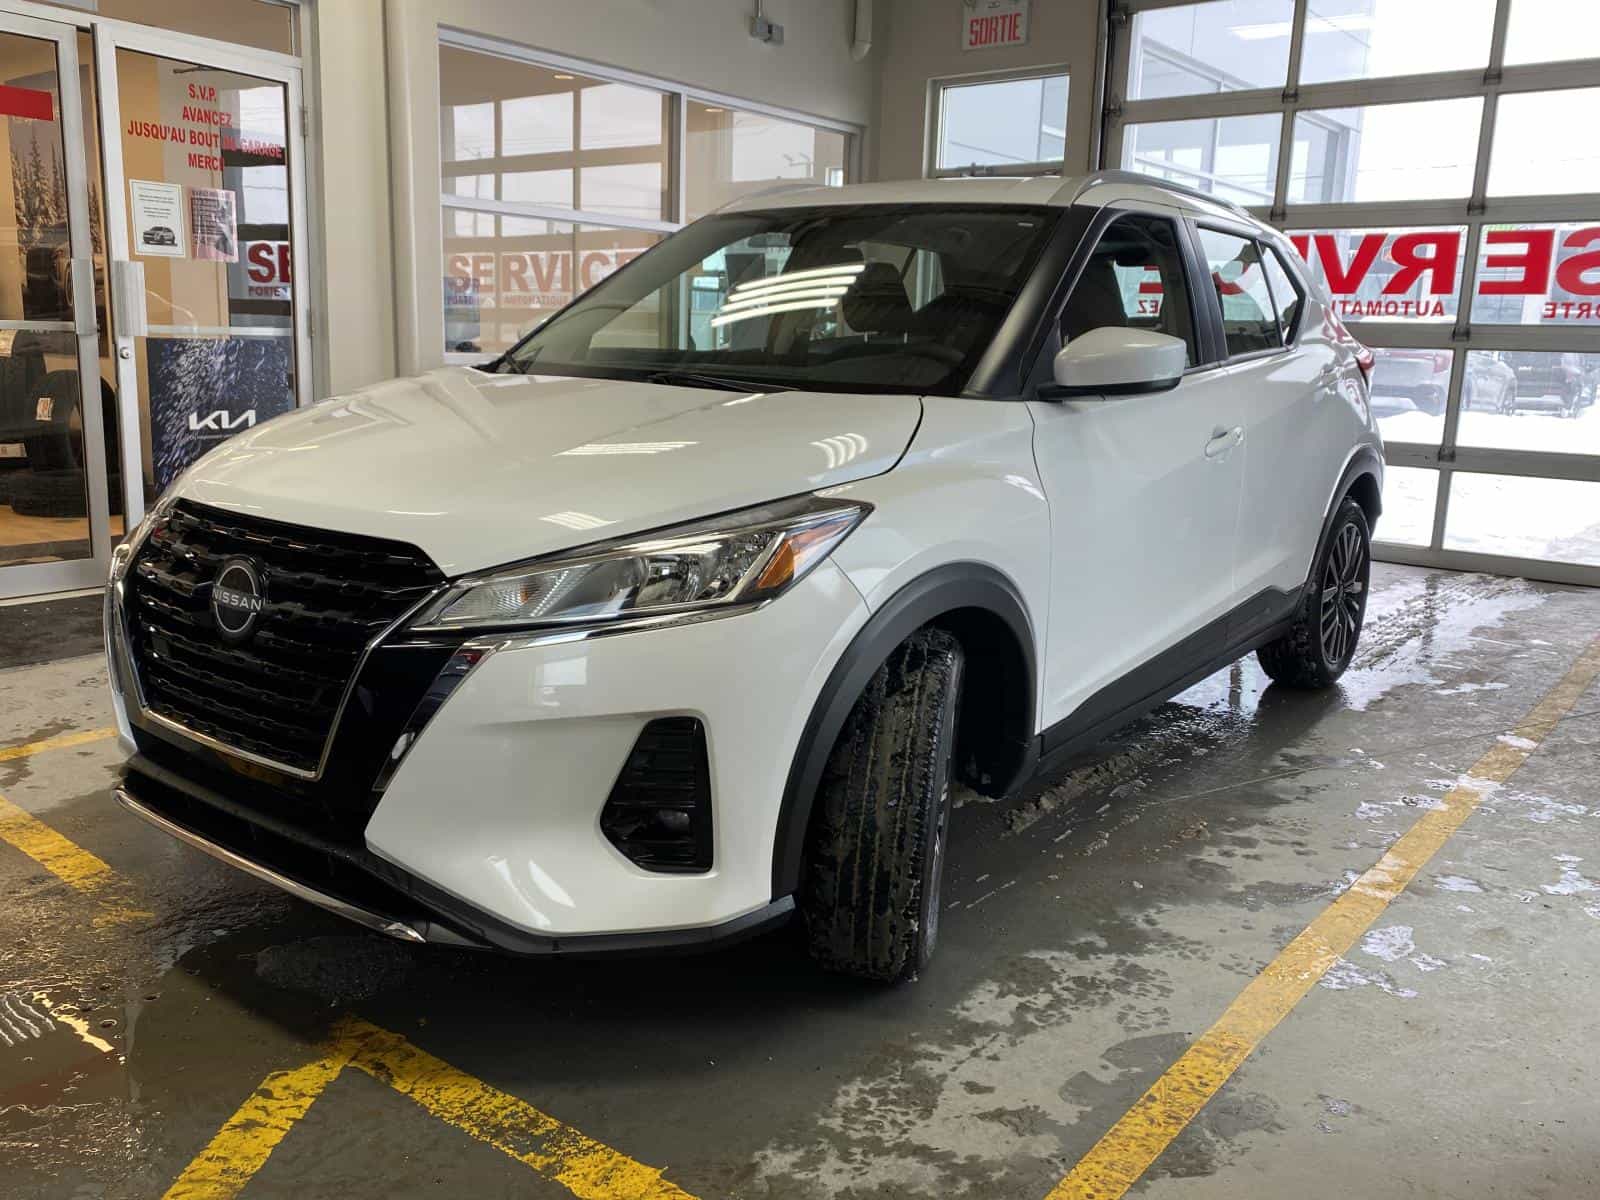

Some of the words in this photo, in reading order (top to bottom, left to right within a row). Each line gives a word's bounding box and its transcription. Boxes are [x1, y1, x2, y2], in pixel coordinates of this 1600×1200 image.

[968, 12, 1022, 46] SORTIE
[188, 83, 217, 102] S.V.P.
[182, 105, 232, 128] AVANCEZ
[127, 119, 186, 143] JUSQU'AU
[189, 130, 219, 149] BOUT
[240, 138, 282, 159] GARAGE
[188, 152, 225, 172] MERCI
[188, 409, 257, 431] KIA
[212, 587, 262, 611] NISSAN
